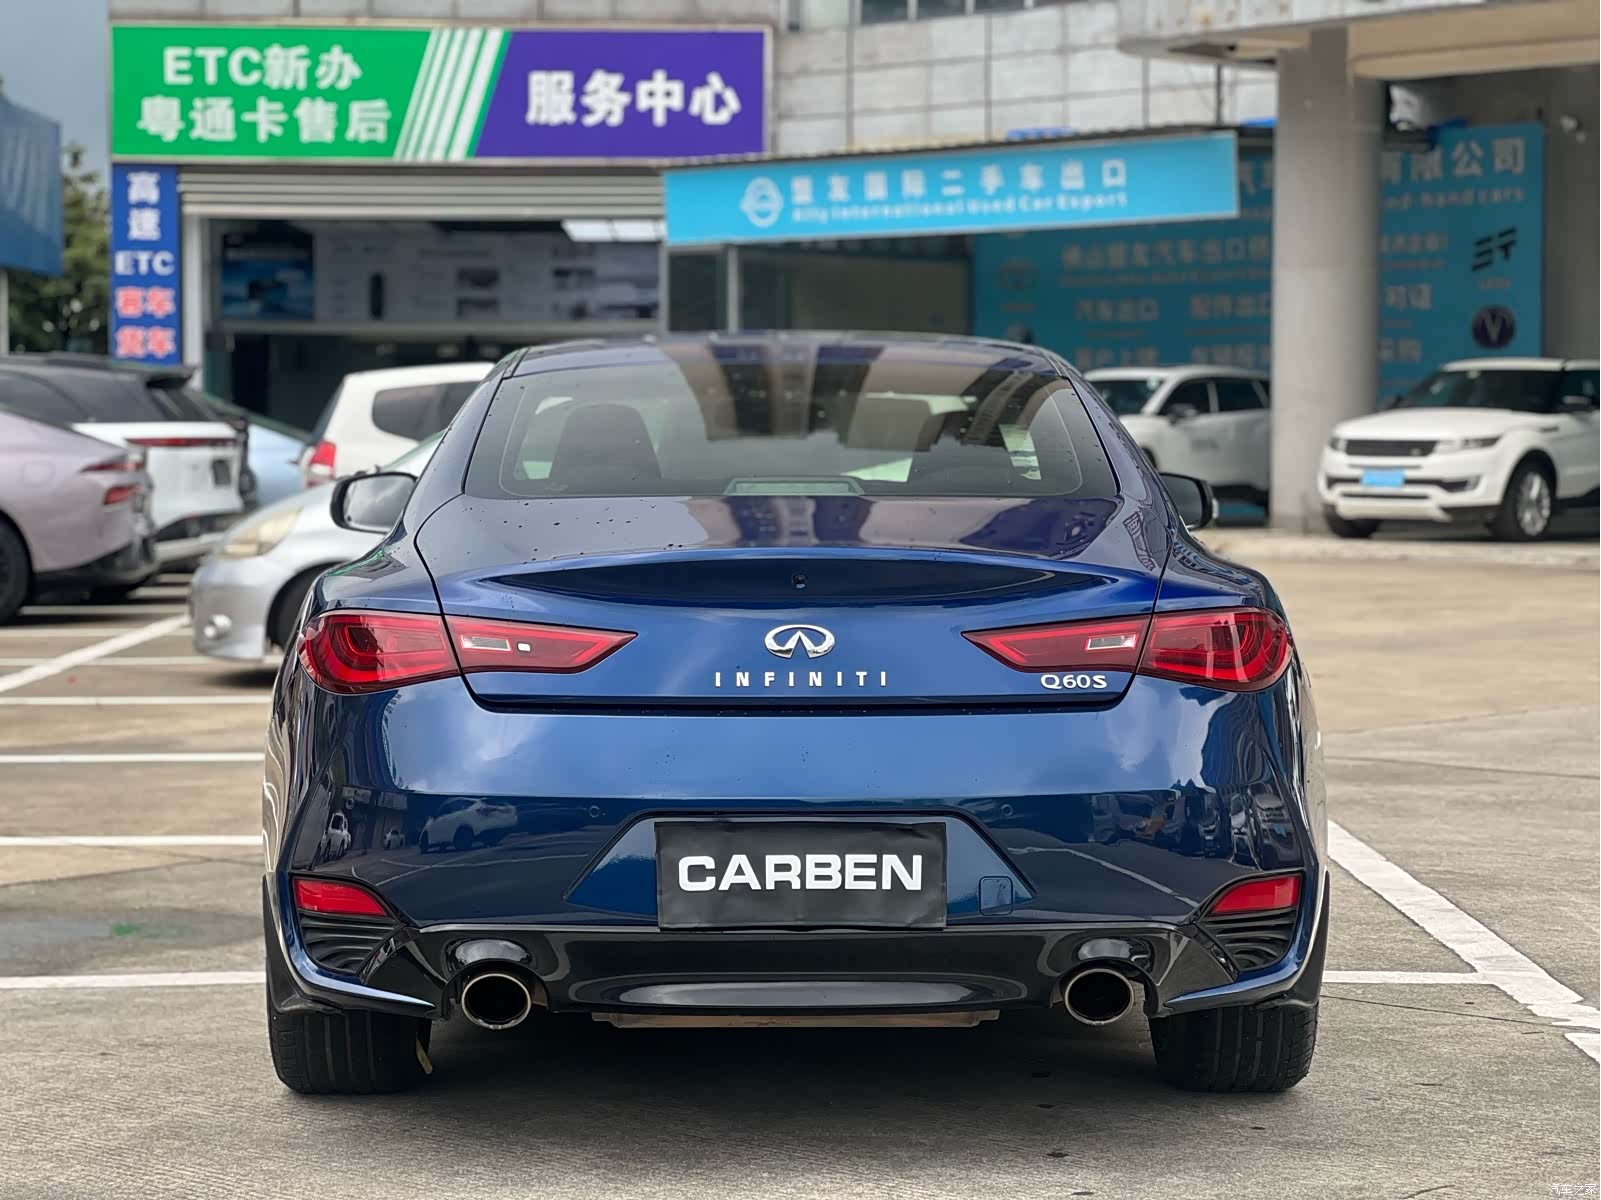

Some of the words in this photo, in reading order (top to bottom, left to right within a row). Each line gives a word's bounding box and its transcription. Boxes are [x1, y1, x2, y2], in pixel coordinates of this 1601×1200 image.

[163, 44, 363, 90] ETC新办
[526, 69, 742, 127] 服务中心
[136, 95, 391, 144] 粤通卡售后
[114, 250, 175, 276] ETC
[115, 325, 175, 358] 货车
[714, 670, 889, 688] INFINITI
[1040, 673, 1108, 690] Q60S
[678, 853, 923, 892] CARBEN
